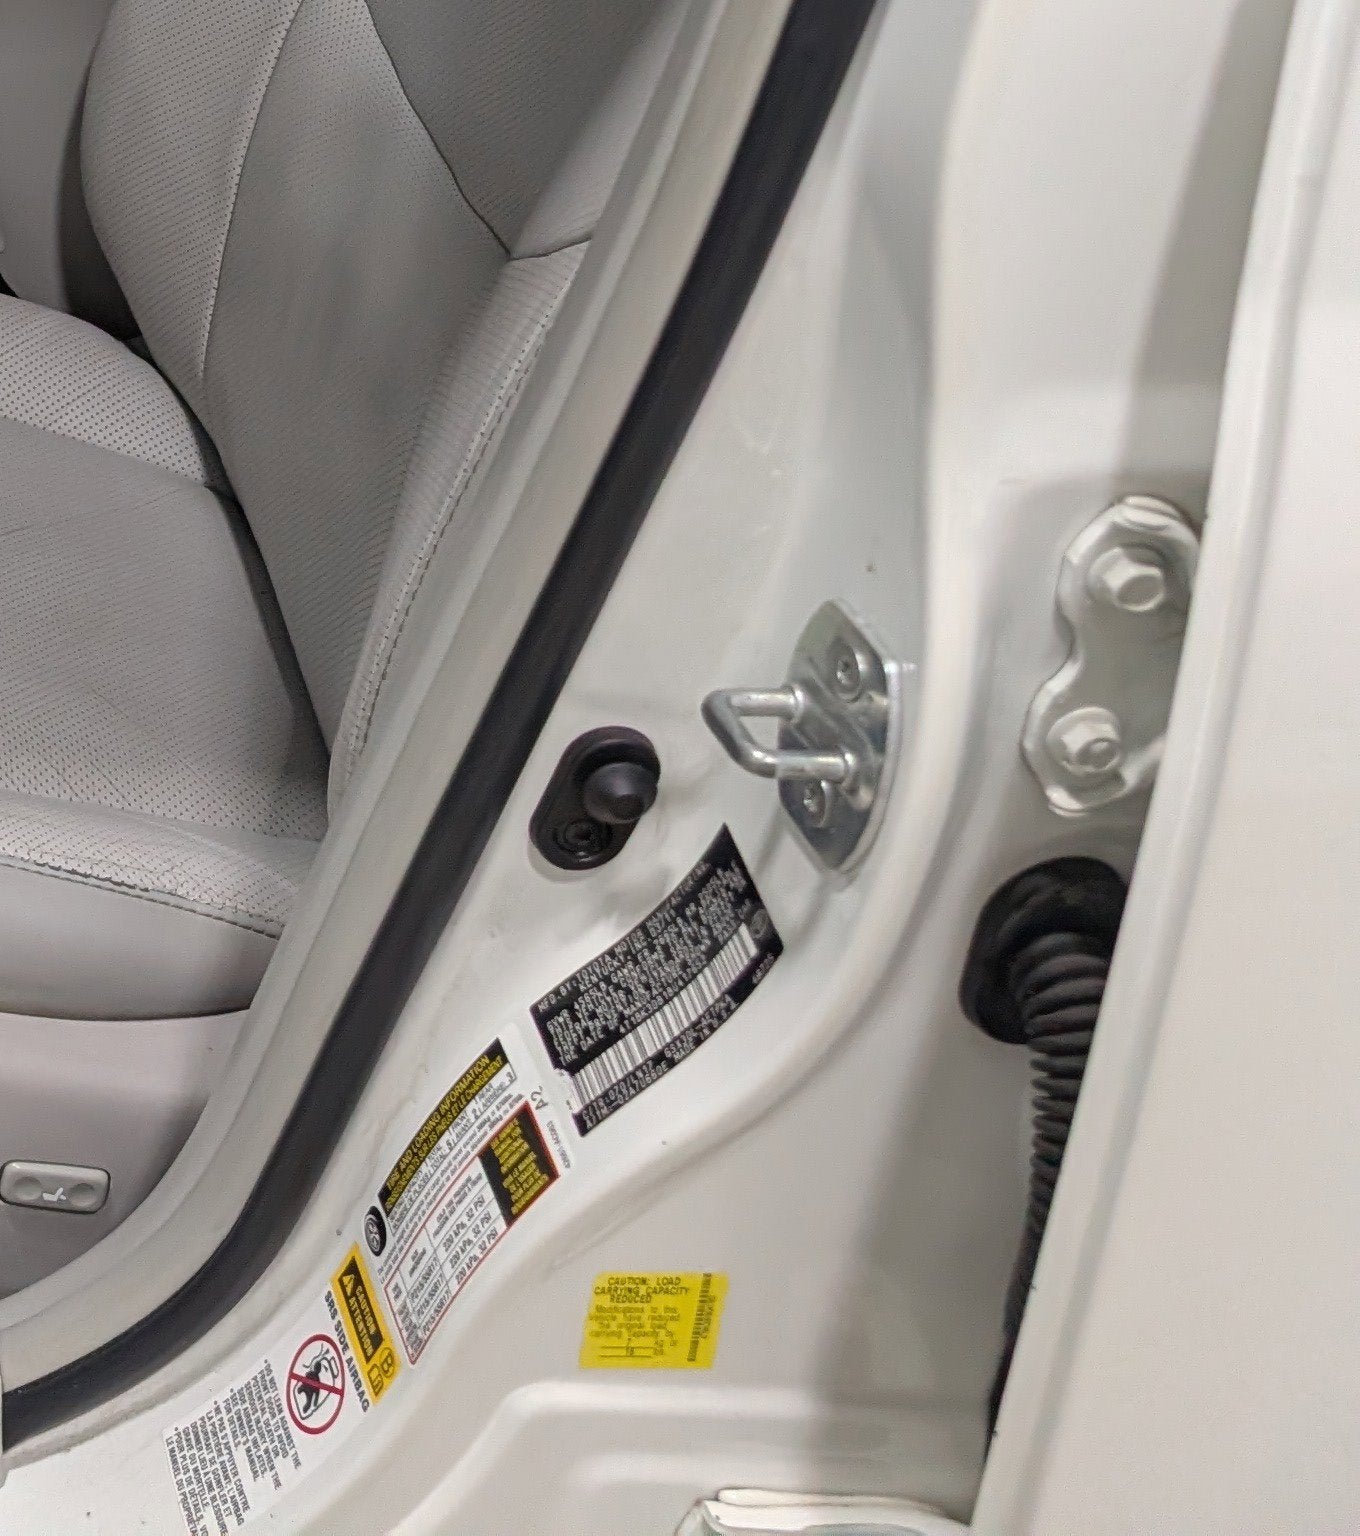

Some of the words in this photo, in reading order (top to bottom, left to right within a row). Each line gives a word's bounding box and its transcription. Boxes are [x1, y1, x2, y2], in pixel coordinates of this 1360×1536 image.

[398, 1147, 413, 1173] AND
[411, 1110, 441, 1154] LOADING
[439, 1052, 490, 1117] INFORMATION
[472, 1192, 485, 1213] PSI
[479, 1208, 492, 1229] PSI
[594, 1286, 640, 1295] CARRYING
[646, 1287, 689, 1295] CAPACITY
[657, 1277, 681, 1286] LOAD
[355, 1285, 376, 1336] CAUTION
[610, 1295, 652, 1303] REDUCED
[348, 1296, 374, 1357] ATTENTION
[325, 1290, 338, 1319] SRS
[334, 1320, 349, 1353] SIDE
[345, 1356, 369, 1412] AIRBAG
[257, 1369, 270, 1396] FRONT
[221, 1397, 232, 1416] FOR
[229, 1392, 239, 1408] SEE
[236, 1386, 247, 1406] SIDE
[264, 1395, 277, 1420] DOOR
[213, 1404, 222, 1416] NE
[241, 1405, 256, 1436] AIRBAG
[249, 1374, 269, 1418] POTENTIAL
[262, 1417, 276, 1445] DEATH
[270, 1444, 280, 1459] OR
[267, 1376, 277, 1394] NOT
[272, 1393, 284, 1415] LEAN
[278, 1414, 295, 1451] AGAINST
[290, 1449, 301, 1469] THE
[196, 1415, 215, 1456] POURRAIT
[216, 1416, 226, 1433] PAS
[232, 1407, 250, 1446] OWNER'S
[242, 1380, 259, 1416] SERIOUS
[252, 1415, 267, 1446] INJURY
[262, 1445, 275, 1472] WHEN
[269, 1470, 281, 1490] THE
[271, 1419, 281, 1433] TO
[164, 1435, 174, 1447] LE
[172, 1430, 186, 1454] POUR
[180, 1425, 195, 1453] GRAVE
[275, 1432, 289, 1459] AVOID
[165, 1445, 183, 1479] MANUEL
[178, 1453, 191, 1476] PLUS
[187, 1452, 197, 1466] OU
[188, 1420, 205, 1453] DONNER
[197, 1451, 208, 1471] LIEU
[204, 1476, 215, 1495] UNE
[205, 1409, 214, 1422] LA
[226, 1486, 245, 1526] L'AIRBAG
[207, 1455, 216, 1467] SE
[218, 1432, 240, 1479] S'APPUYER
[243, 1444, 261, 1482] MANUAL
[175, 1477, 185, 1492] DU
[184, 1474, 194, 1488] DE
[210, 1466, 229, 1507] GONFLER
[233, 1477, 250, 1513] CONTRE
[222, 1505, 232, 1519] ET
